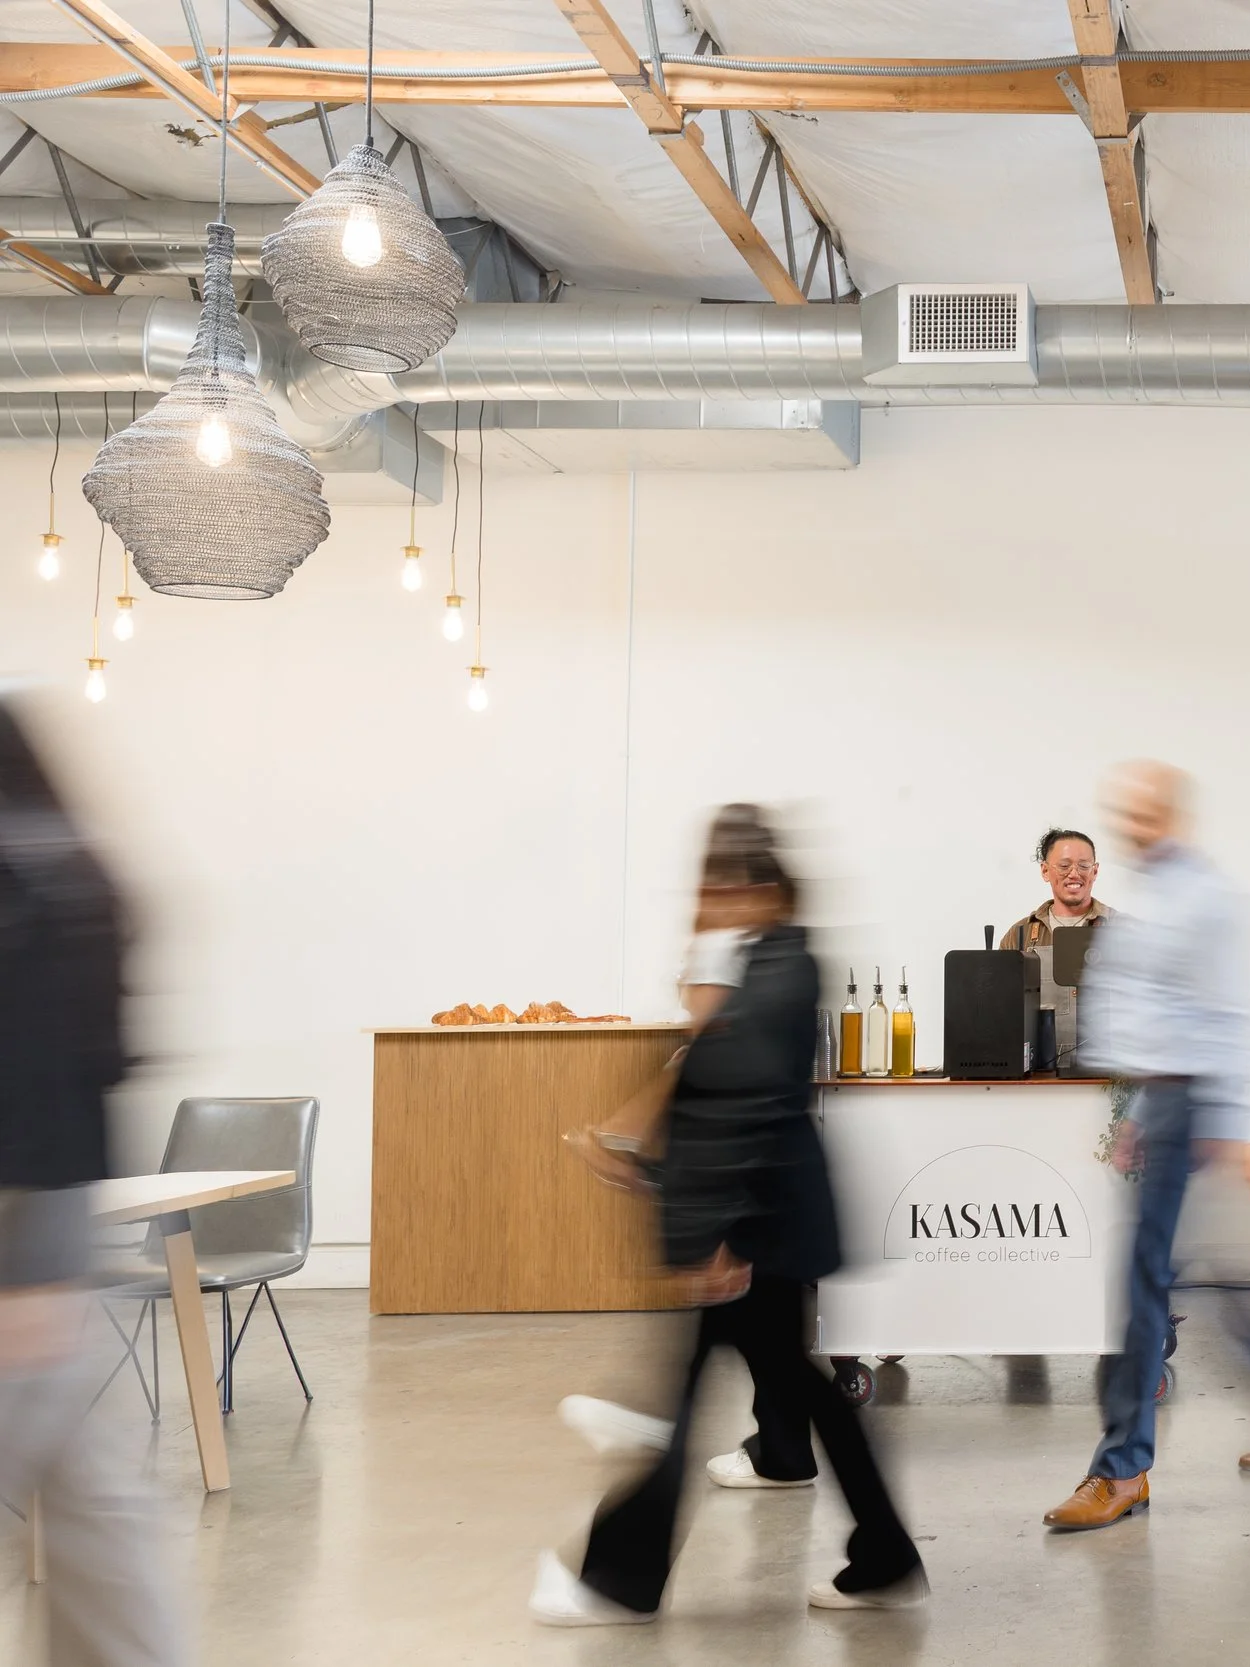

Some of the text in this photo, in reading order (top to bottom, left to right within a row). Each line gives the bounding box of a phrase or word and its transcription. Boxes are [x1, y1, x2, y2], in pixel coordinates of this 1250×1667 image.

[908, 1202, 1070, 1240] KASAMA
[914, 1245, 1060, 1263] coffee collective
